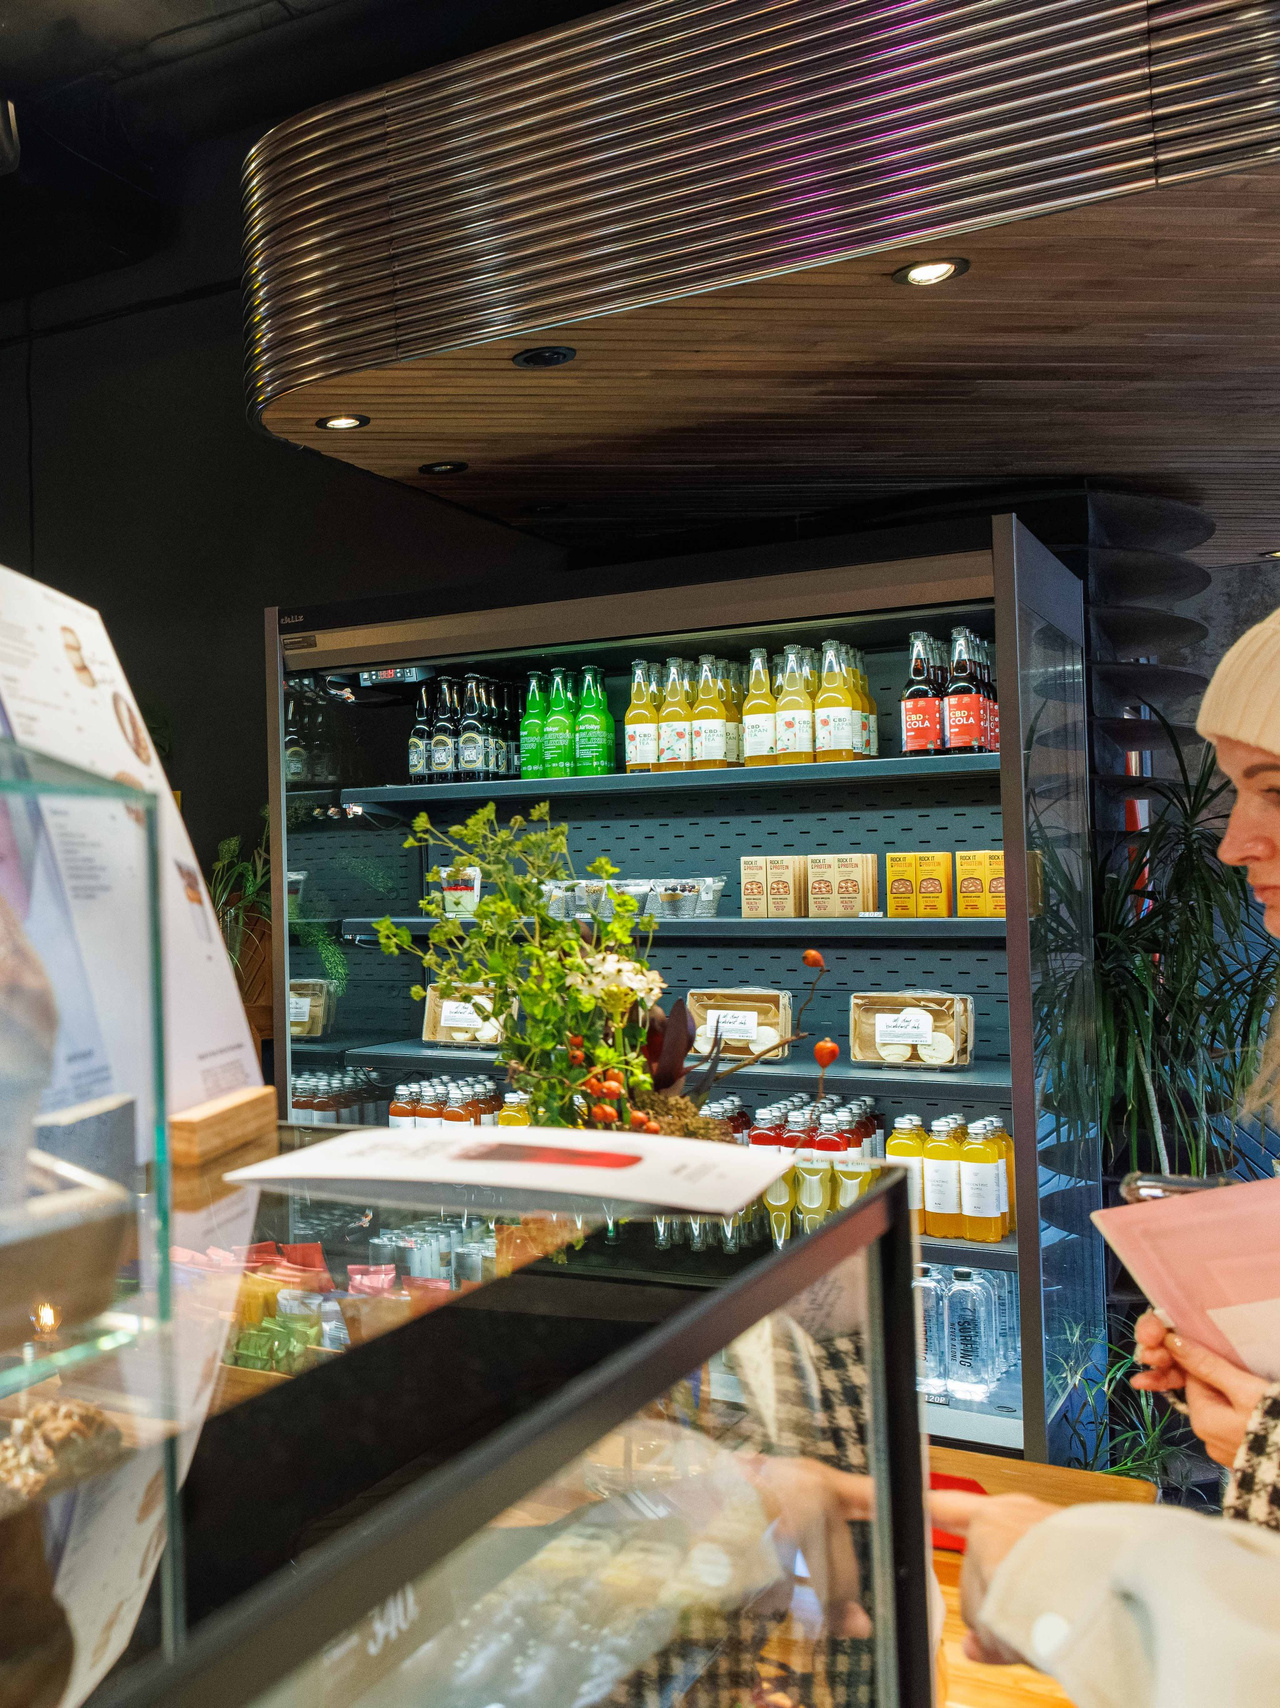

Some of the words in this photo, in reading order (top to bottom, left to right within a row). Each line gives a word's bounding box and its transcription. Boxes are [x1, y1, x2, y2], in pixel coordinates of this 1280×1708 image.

[906, 713, 923, 721] CBD
[949, 710, 968, 718] CBD
[906, 720, 931, 729] COLA
[949, 716, 975, 725] COLA
[958, 1320, 972, 1368] SURFING
[950, 1343, 958, 1362] ALONE
